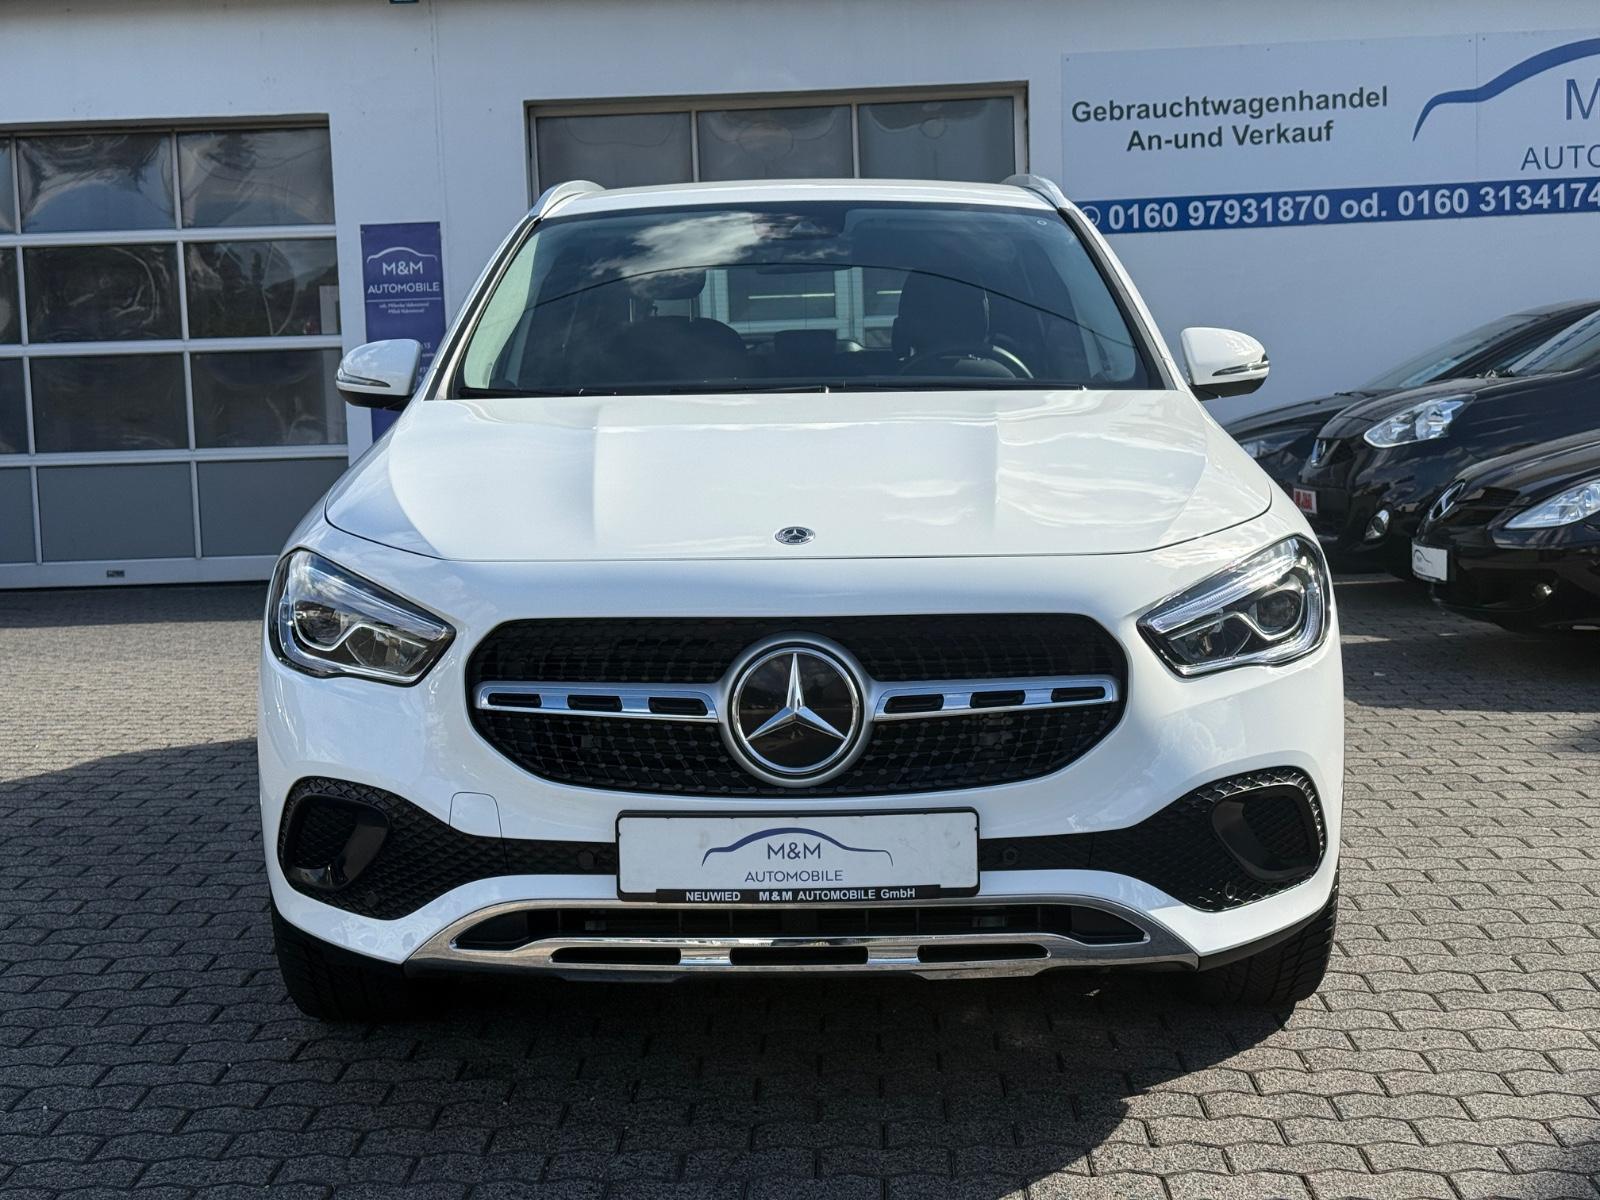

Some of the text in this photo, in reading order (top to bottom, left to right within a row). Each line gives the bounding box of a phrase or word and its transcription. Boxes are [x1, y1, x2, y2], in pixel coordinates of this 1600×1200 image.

[1071, 86, 1388, 123] Gebrauchtwagenhandel
[1126, 120, 1334, 152] An-und Verkauf
[1108, 181, 1600, 230] 0160 97931870 od. 0160 3134174
[382, 261, 423, 276] M&M
[367, 282, 440, 294] AUTOMOBILE
[766, 842, 822, 861] M&M
[744, 870, 844, 884] AUTOMOBILE
[685, 891, 741, 902] NEUWIED
[797, 889, 876, 901] AUTOMOBILE
[880, 888, 916, 900] GmbH
